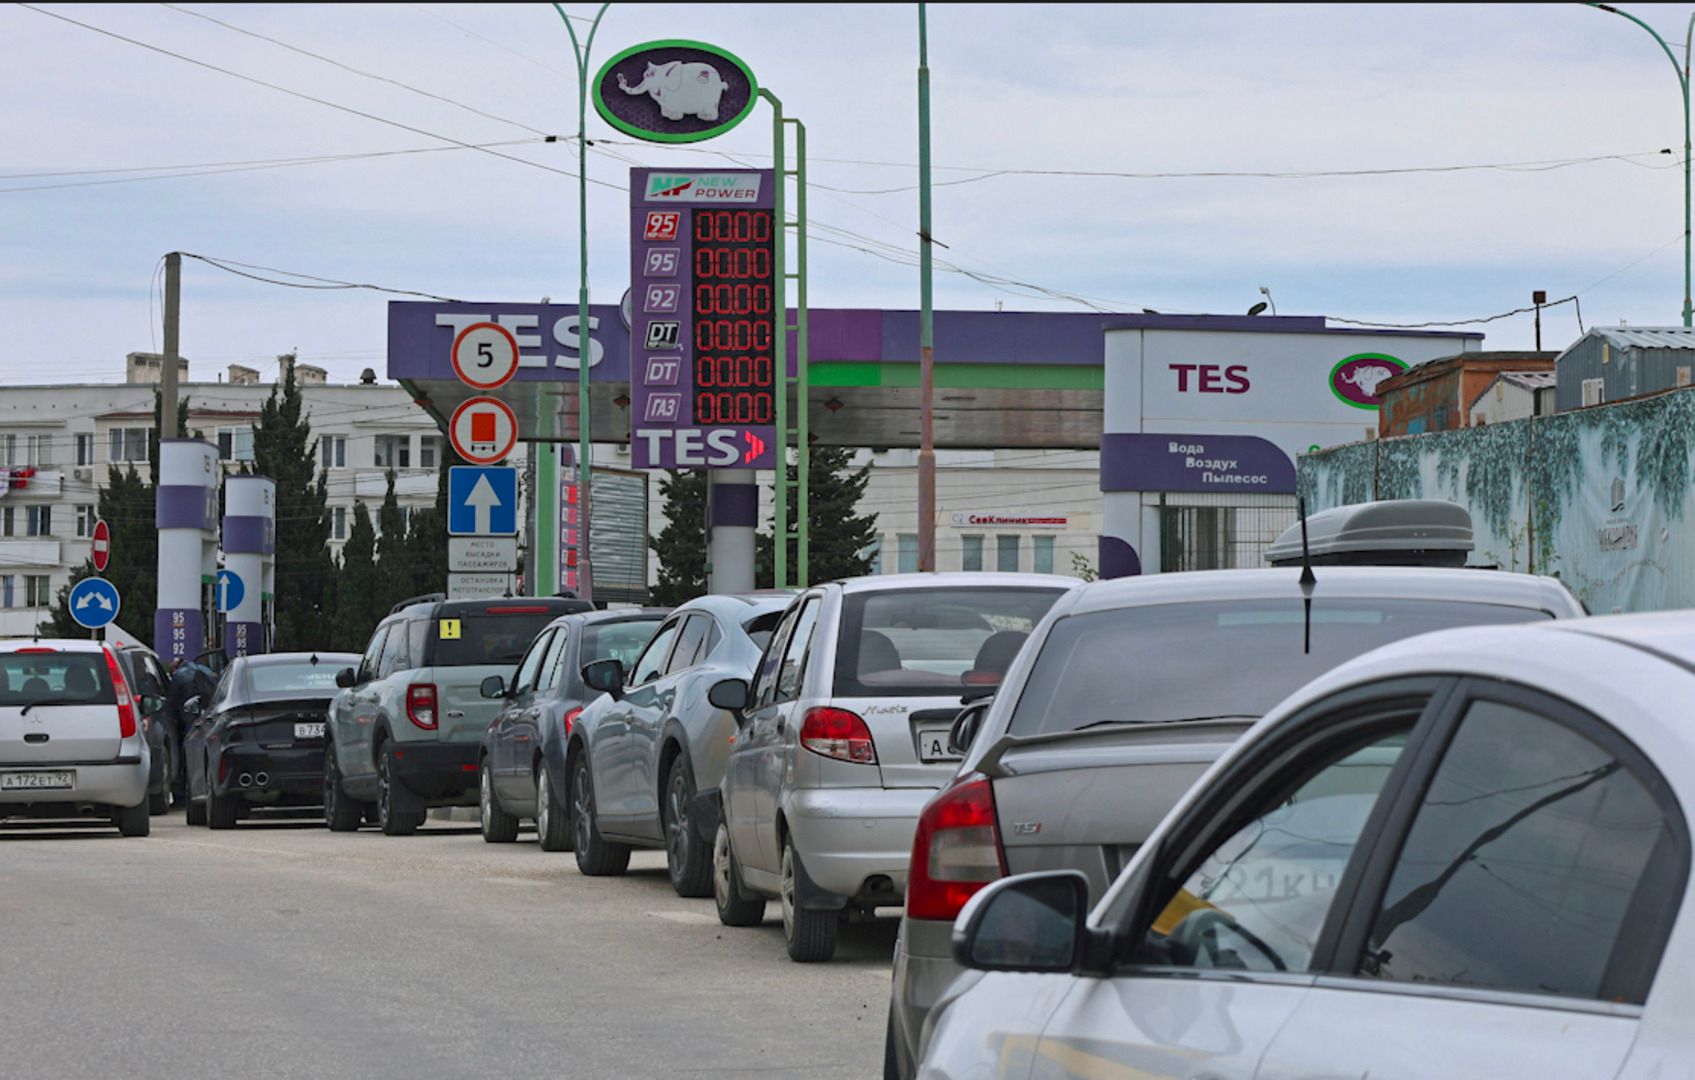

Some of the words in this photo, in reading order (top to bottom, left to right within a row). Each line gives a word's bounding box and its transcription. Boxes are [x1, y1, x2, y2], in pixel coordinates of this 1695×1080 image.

[697, 177, 737, 187] NEW
[694, 188, 756, 198] POWER
[650, 215, 675, 233] 95
[650, 253, 674, 272] 95
[650, 289, 675, 308] 92
[649, 323, 677, 342] DT
[476, 342, 494, 368] 5
[649, 362, 677, 381] DT
[1168, 363, 1251, 394] TES
[651, 398, 676, 417] ГАЗ
[635, 428, 740, 467] TES
[1168, 442, 1205, 455] Вода
[1185, 457, 1238, 471] Воздух
[1202, 471, 1268, 484] Пылесос
[465, 551, 501, 559] ВЫСАДКИ
[457, 560, 508, 568] ПАССАЖИРОВ
[173, 611, 185, 624] 95
[173, 628, 185, 640] 95
[173, 643, 185, 655] 92
